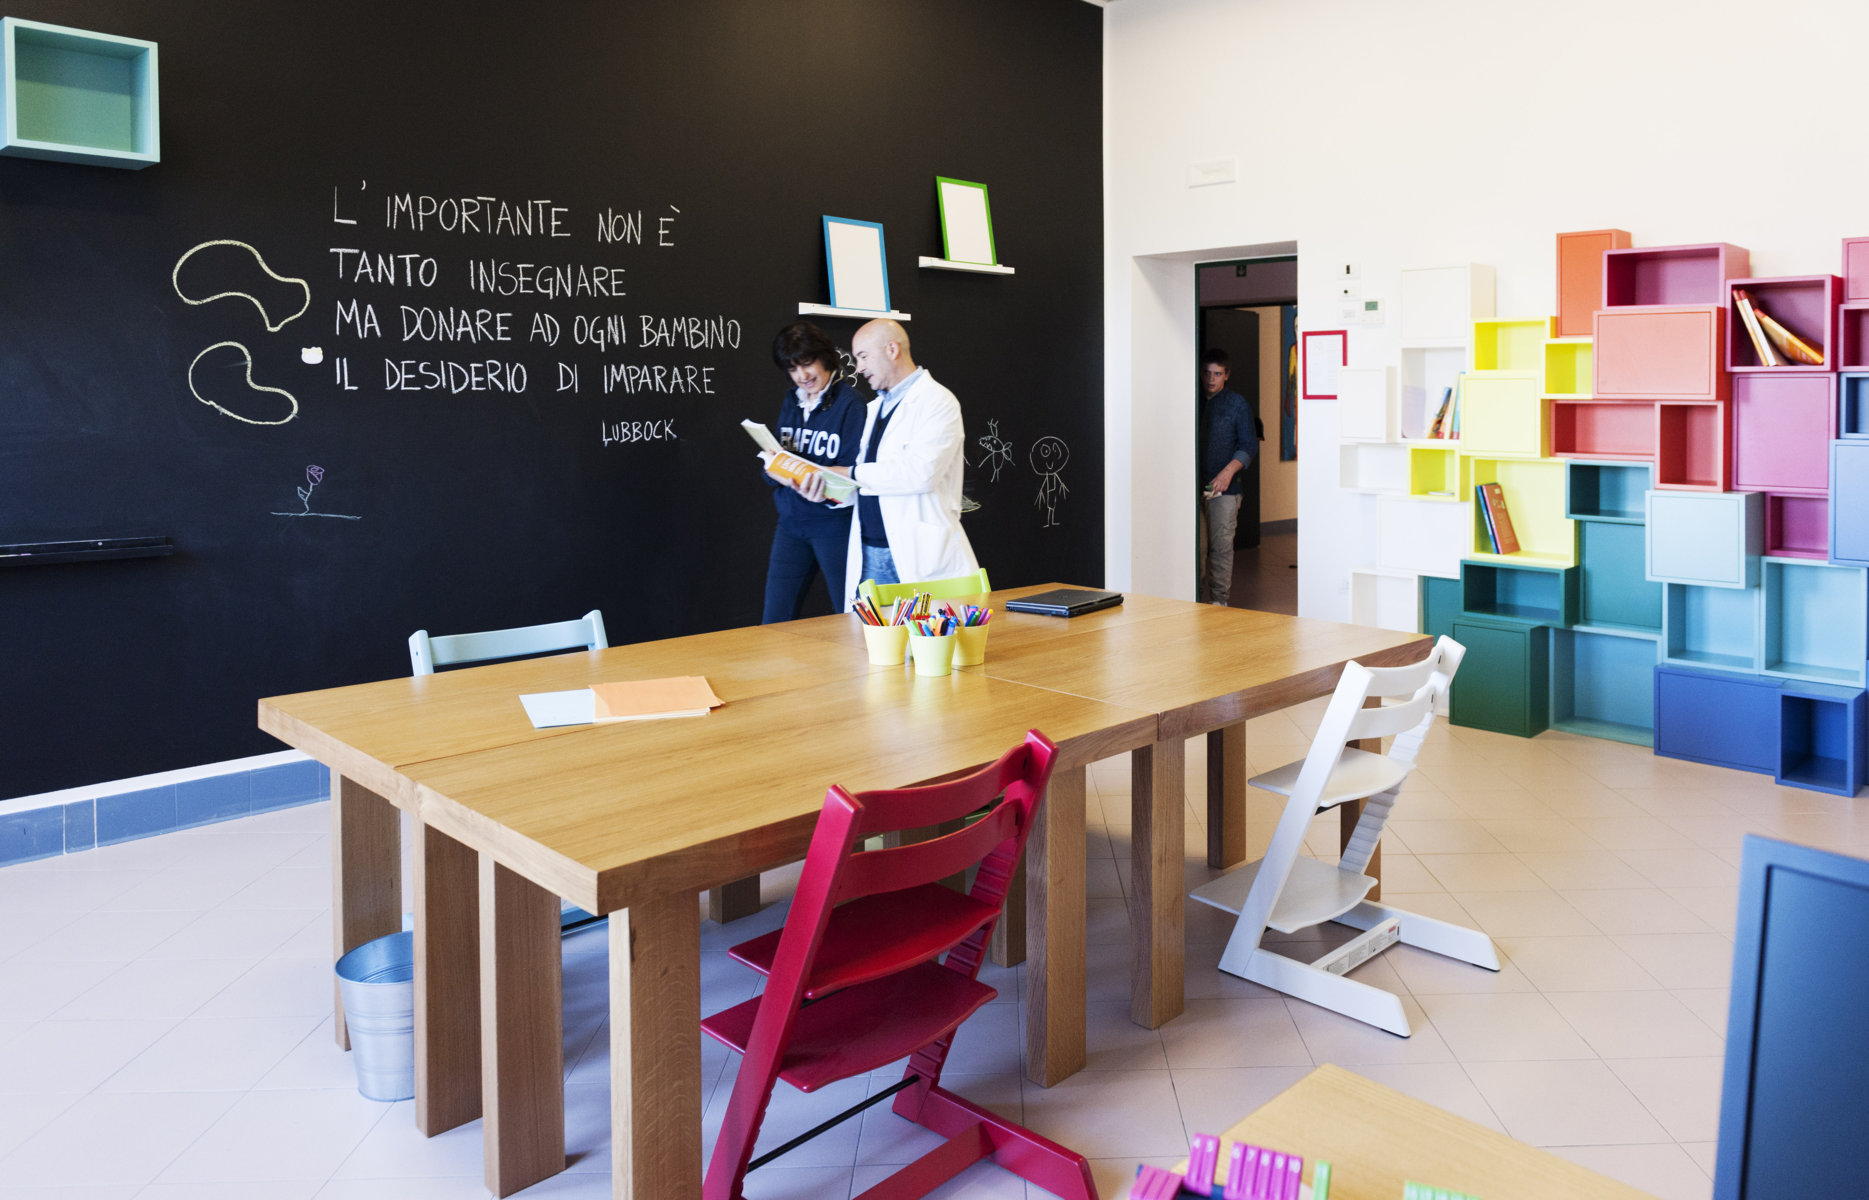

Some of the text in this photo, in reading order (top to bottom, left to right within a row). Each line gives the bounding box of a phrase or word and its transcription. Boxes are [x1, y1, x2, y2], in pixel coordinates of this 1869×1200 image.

[387, 193, 571, 237] IMPORTANTE
[598, 208, 641, 245] NON
[659, 205, 680, 246] È
[330, 248, 626, 299] TANTO INSEGNARE
[336, 299, 740, 352] MA DONARE AD OGNI BAMBINO
[336, 357, 715, 394] IL DESIDERIO DI IMPARARE
[603, 419, 677, 446] LUBBOCK
[1247, 1149, 1255, 1161] 7
[1289, 1158, 1301, 1174] 10
